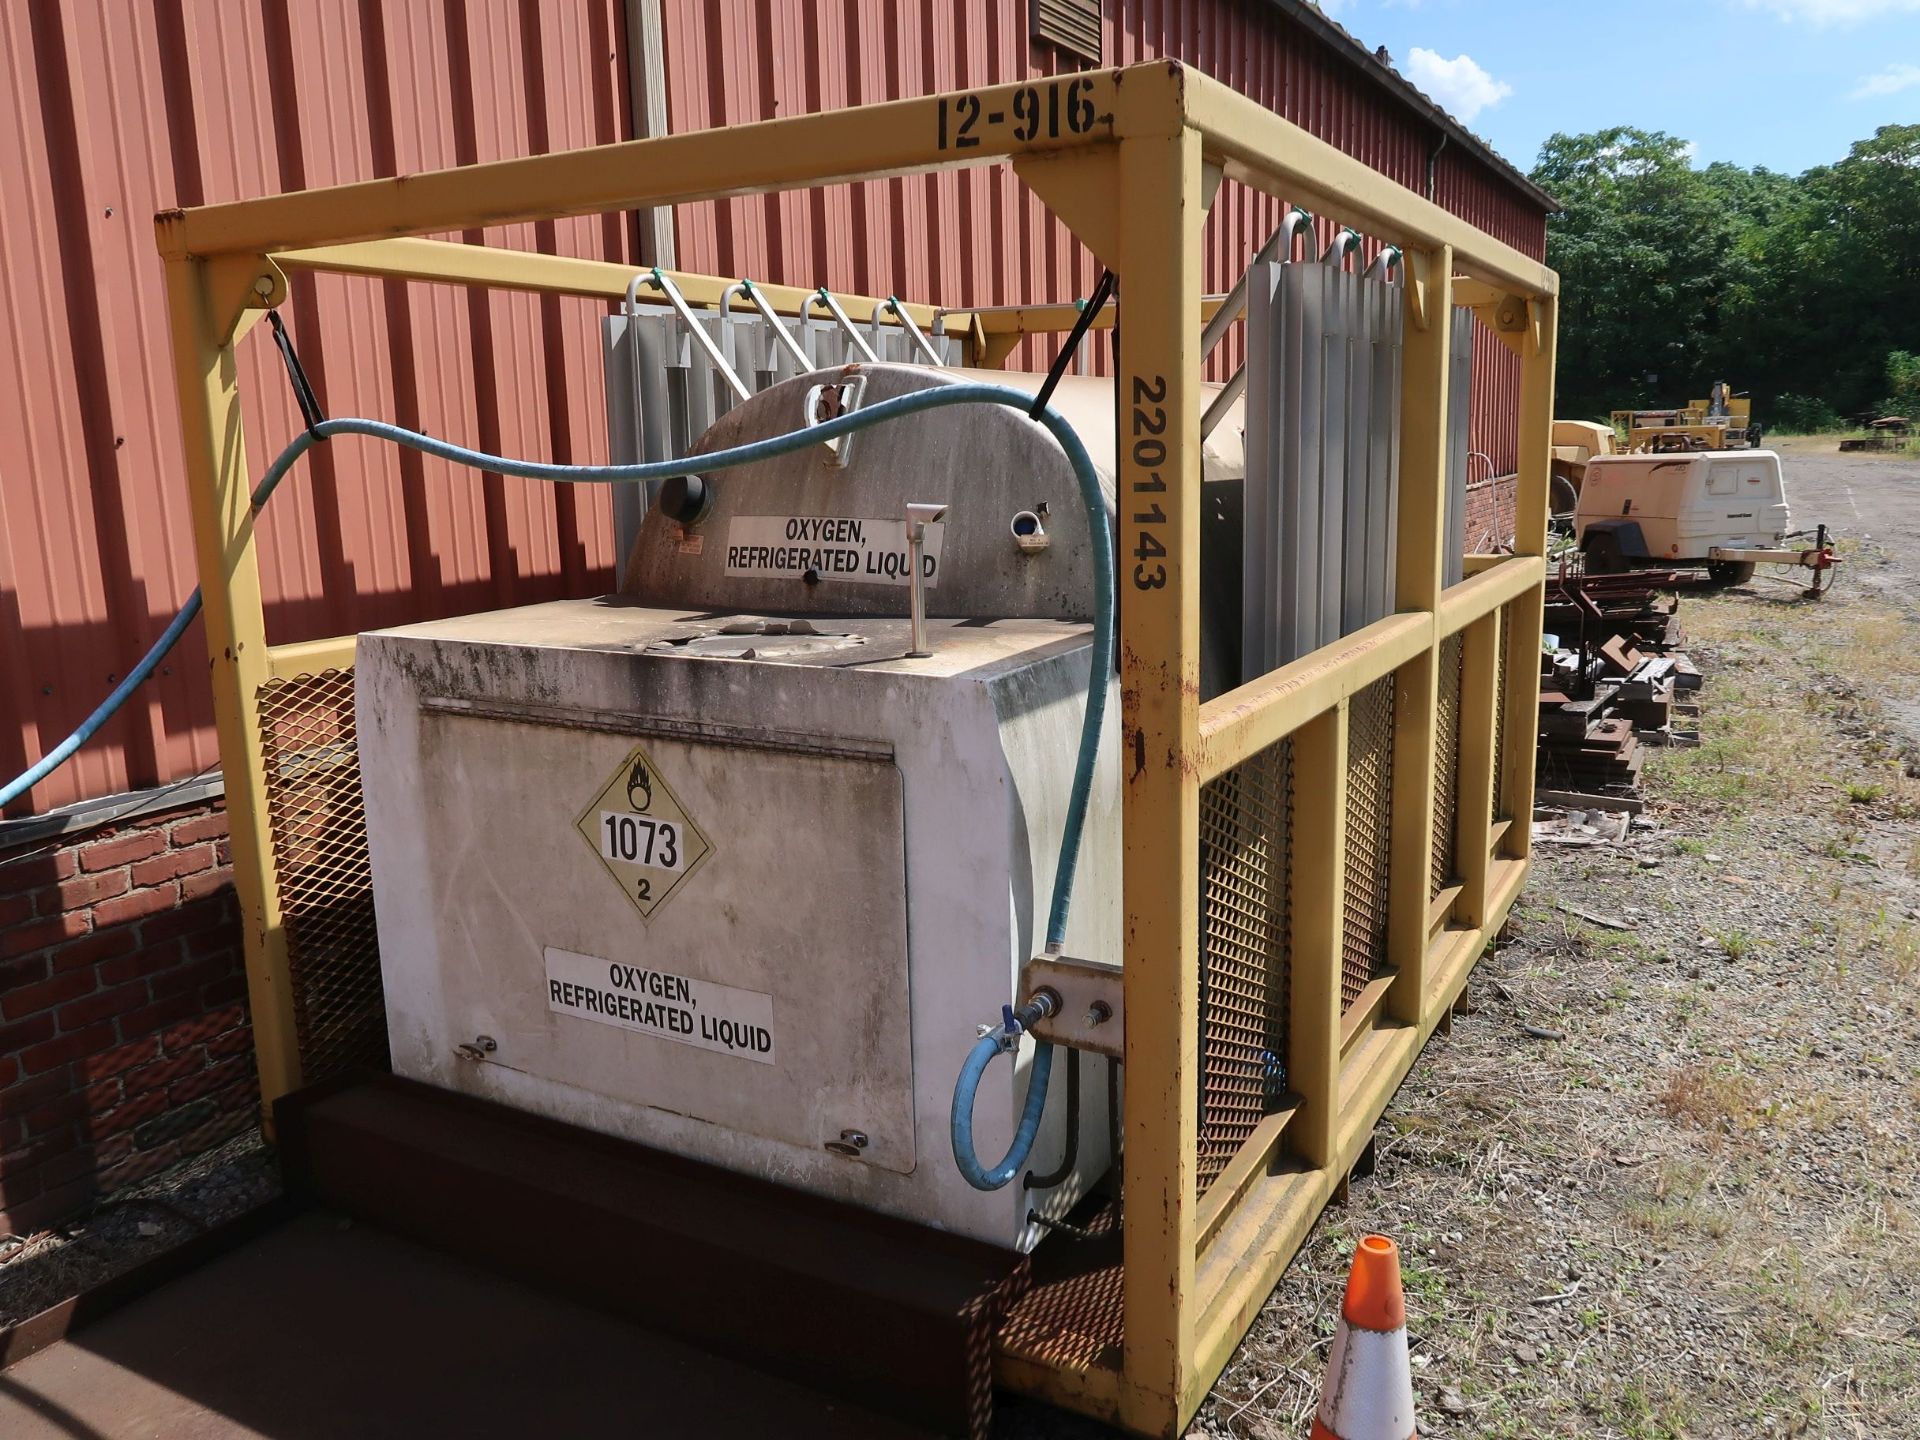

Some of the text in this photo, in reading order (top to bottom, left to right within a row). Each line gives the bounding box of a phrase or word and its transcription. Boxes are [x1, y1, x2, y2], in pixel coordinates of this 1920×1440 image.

[938, 78, 1095, 150] 12-916
[1133, 375, 1167, 592] 2201143
[785, 518, 867, 548] OXYGEN,
[727, 546, 936, 580] REFRIGERATED LIQUD
[605, 815, 677, 868] 1073
[637, 878, 651, 901] 2
[609, 963, 697, 1010] OXYGEN,
[549, 979, 694, 1035] REFRIGERATED
[701, 1014, 771, 1053] LIQUID
